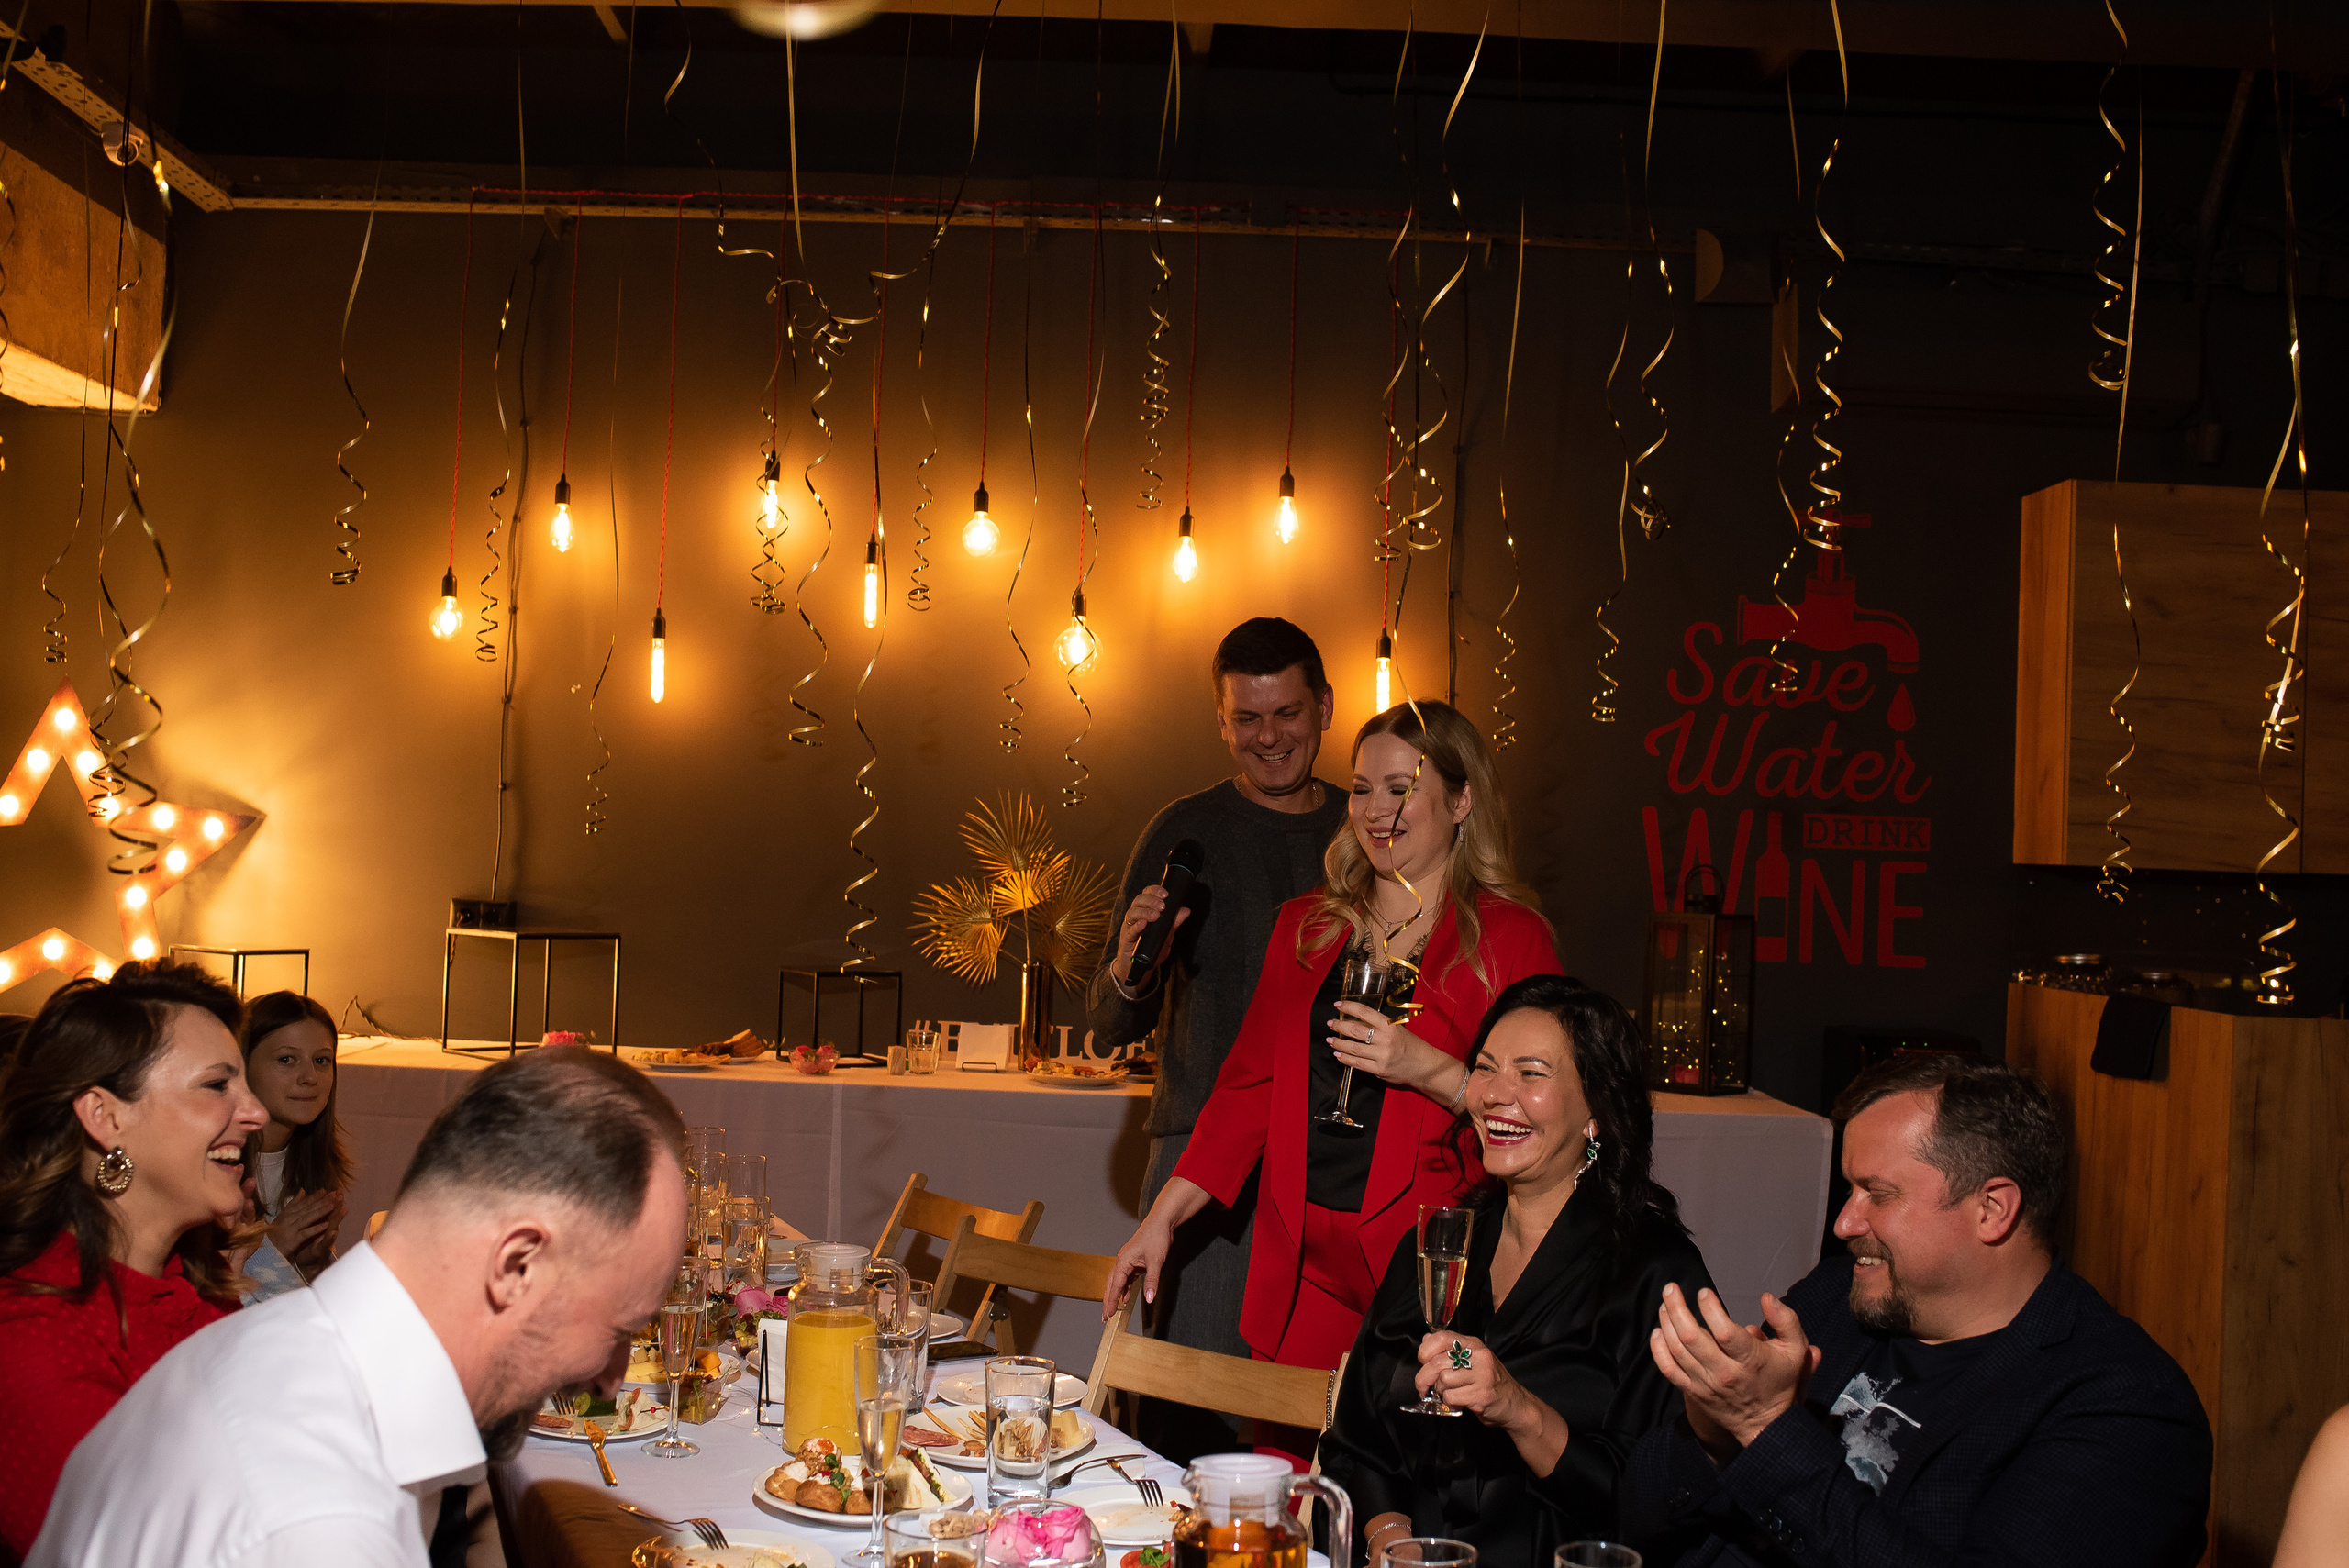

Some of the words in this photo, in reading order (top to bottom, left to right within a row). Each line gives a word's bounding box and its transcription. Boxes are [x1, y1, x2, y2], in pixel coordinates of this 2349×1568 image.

[1667, 621, 1876, 712] Save
[1644, 710, 1932, 804] Water
[1805, 817, 1928, 849] DRINK
[1642, 806, 1928, 969] WINE
